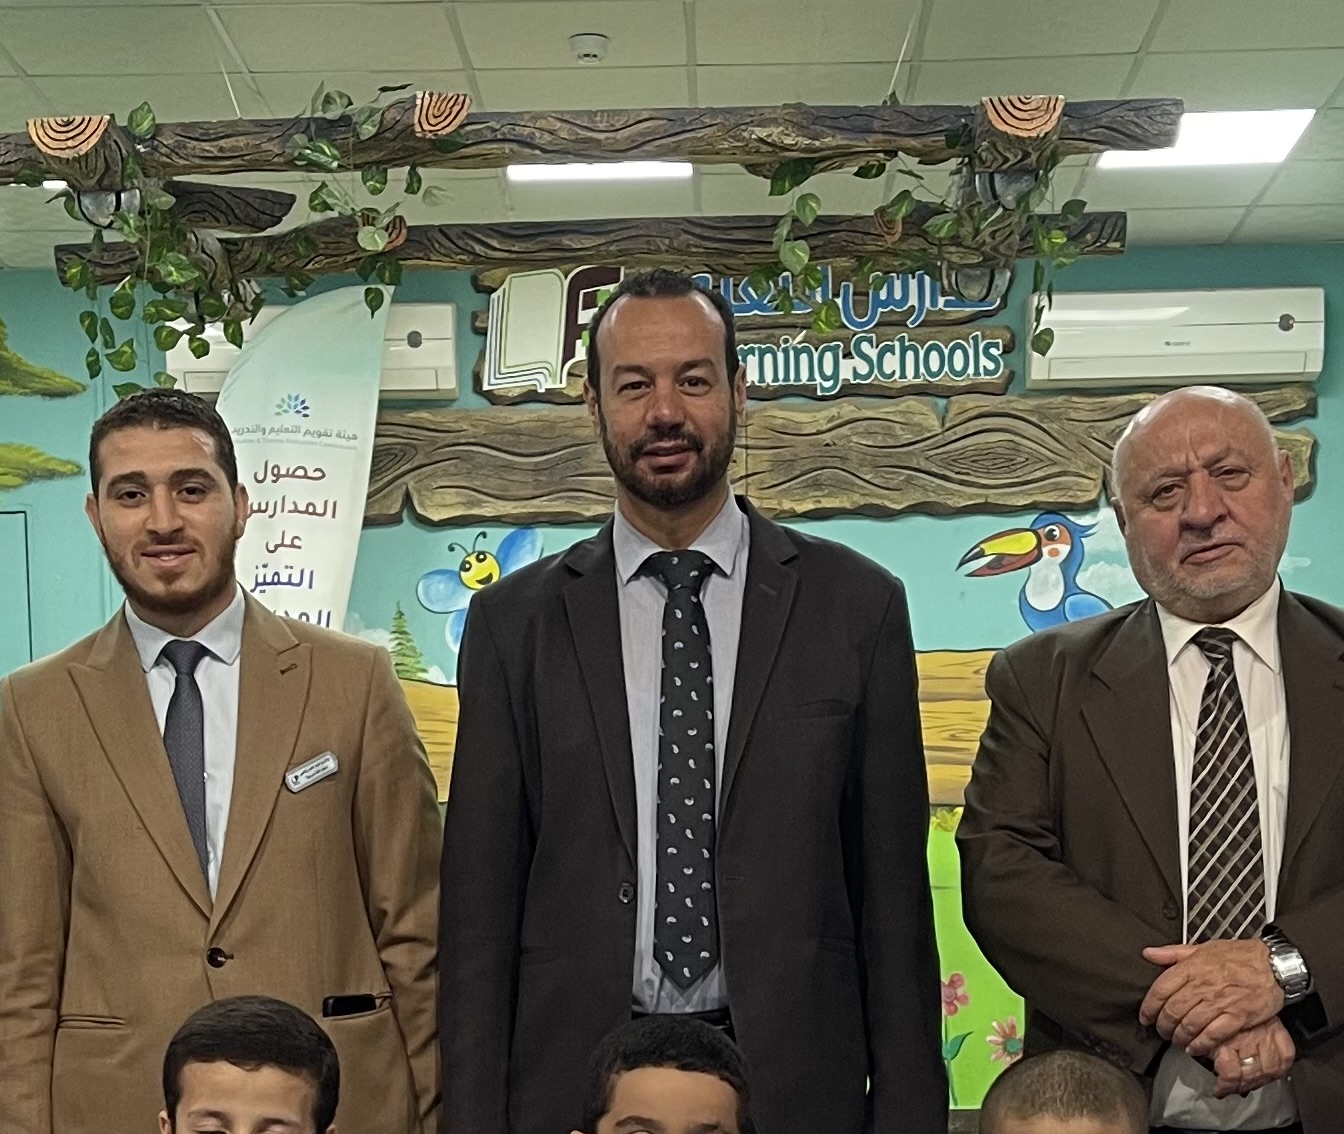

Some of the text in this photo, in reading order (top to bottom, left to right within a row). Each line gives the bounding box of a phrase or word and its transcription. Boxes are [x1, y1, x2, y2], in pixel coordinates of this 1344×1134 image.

[853, 333, 1003, 384] Schools
[254, 460, 326, 484] حصول
[266, 530, 302, 553] على
